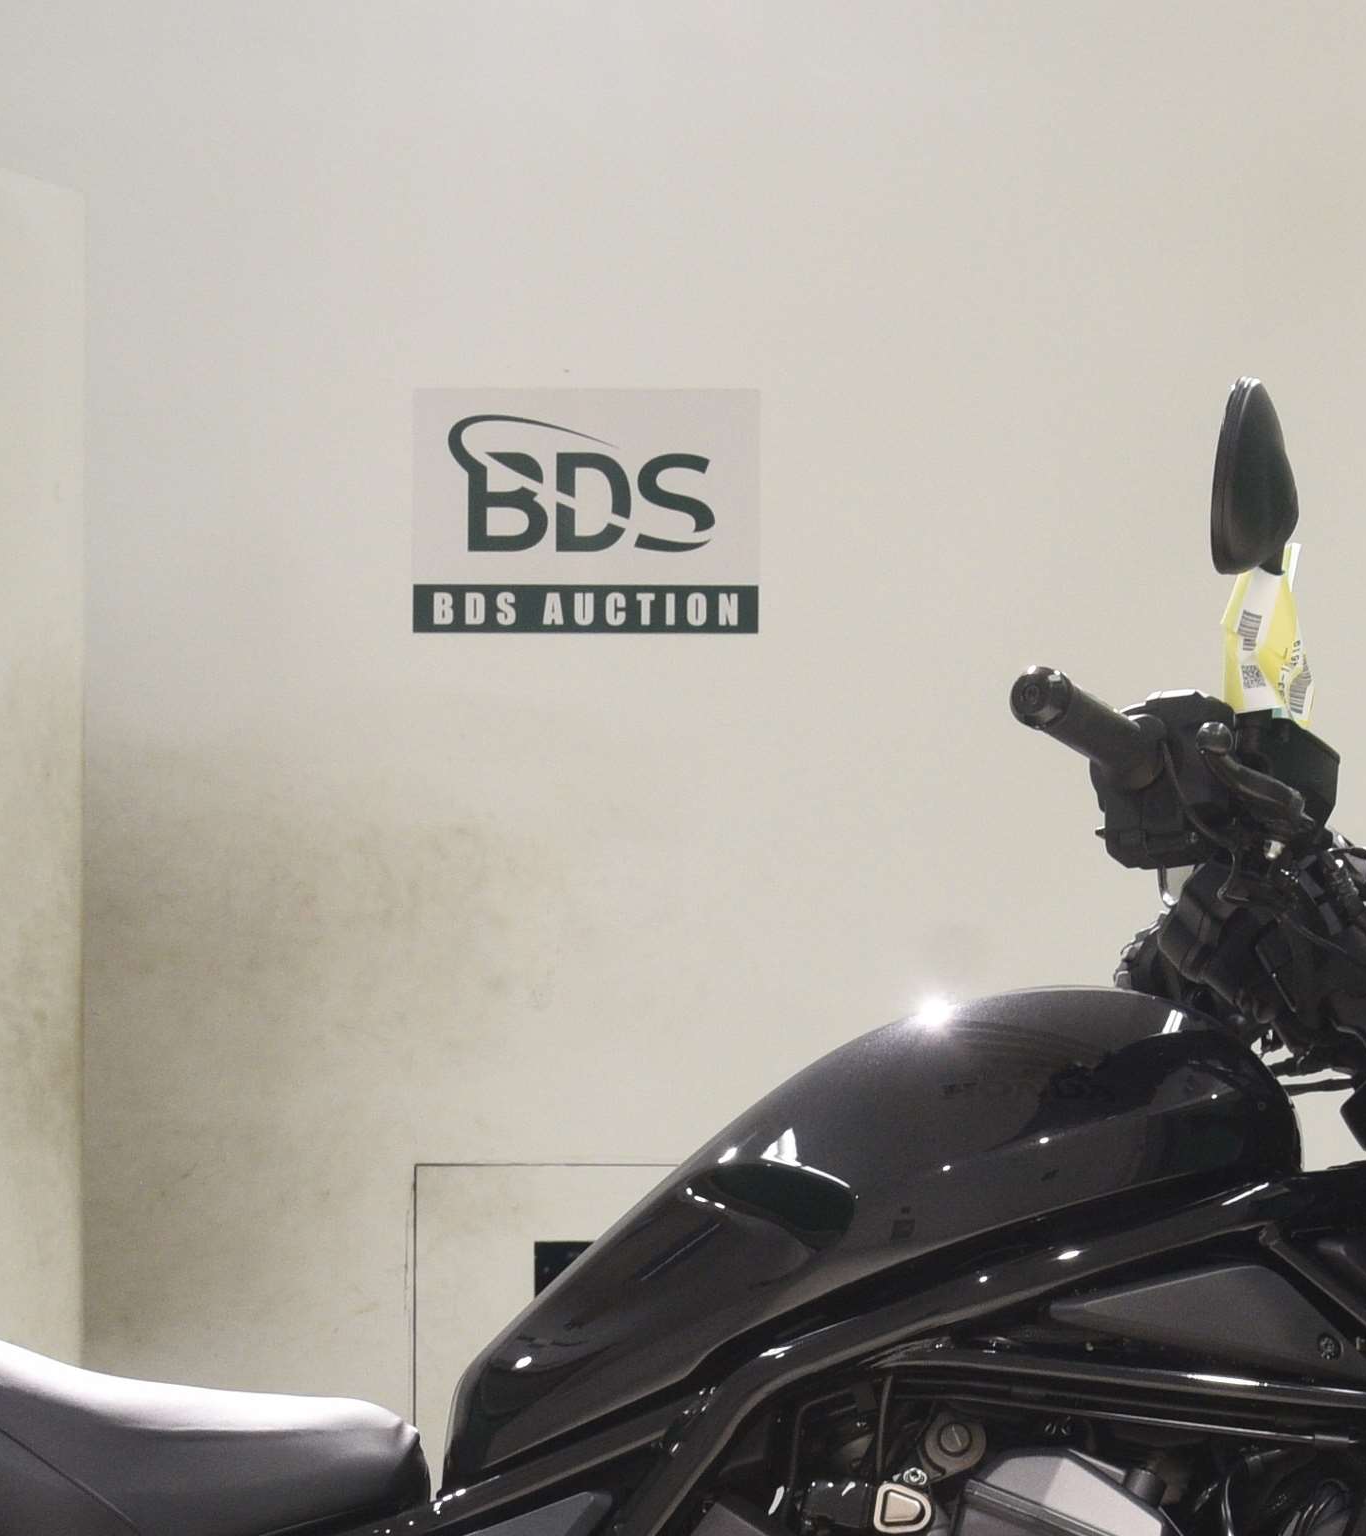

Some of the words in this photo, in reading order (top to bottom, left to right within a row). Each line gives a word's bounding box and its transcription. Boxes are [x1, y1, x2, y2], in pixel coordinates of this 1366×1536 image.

[449, 414, 715, 552] BDS
[432, 591, 517, 626] BDS
[542, 592, 739, 627] AUCTION
